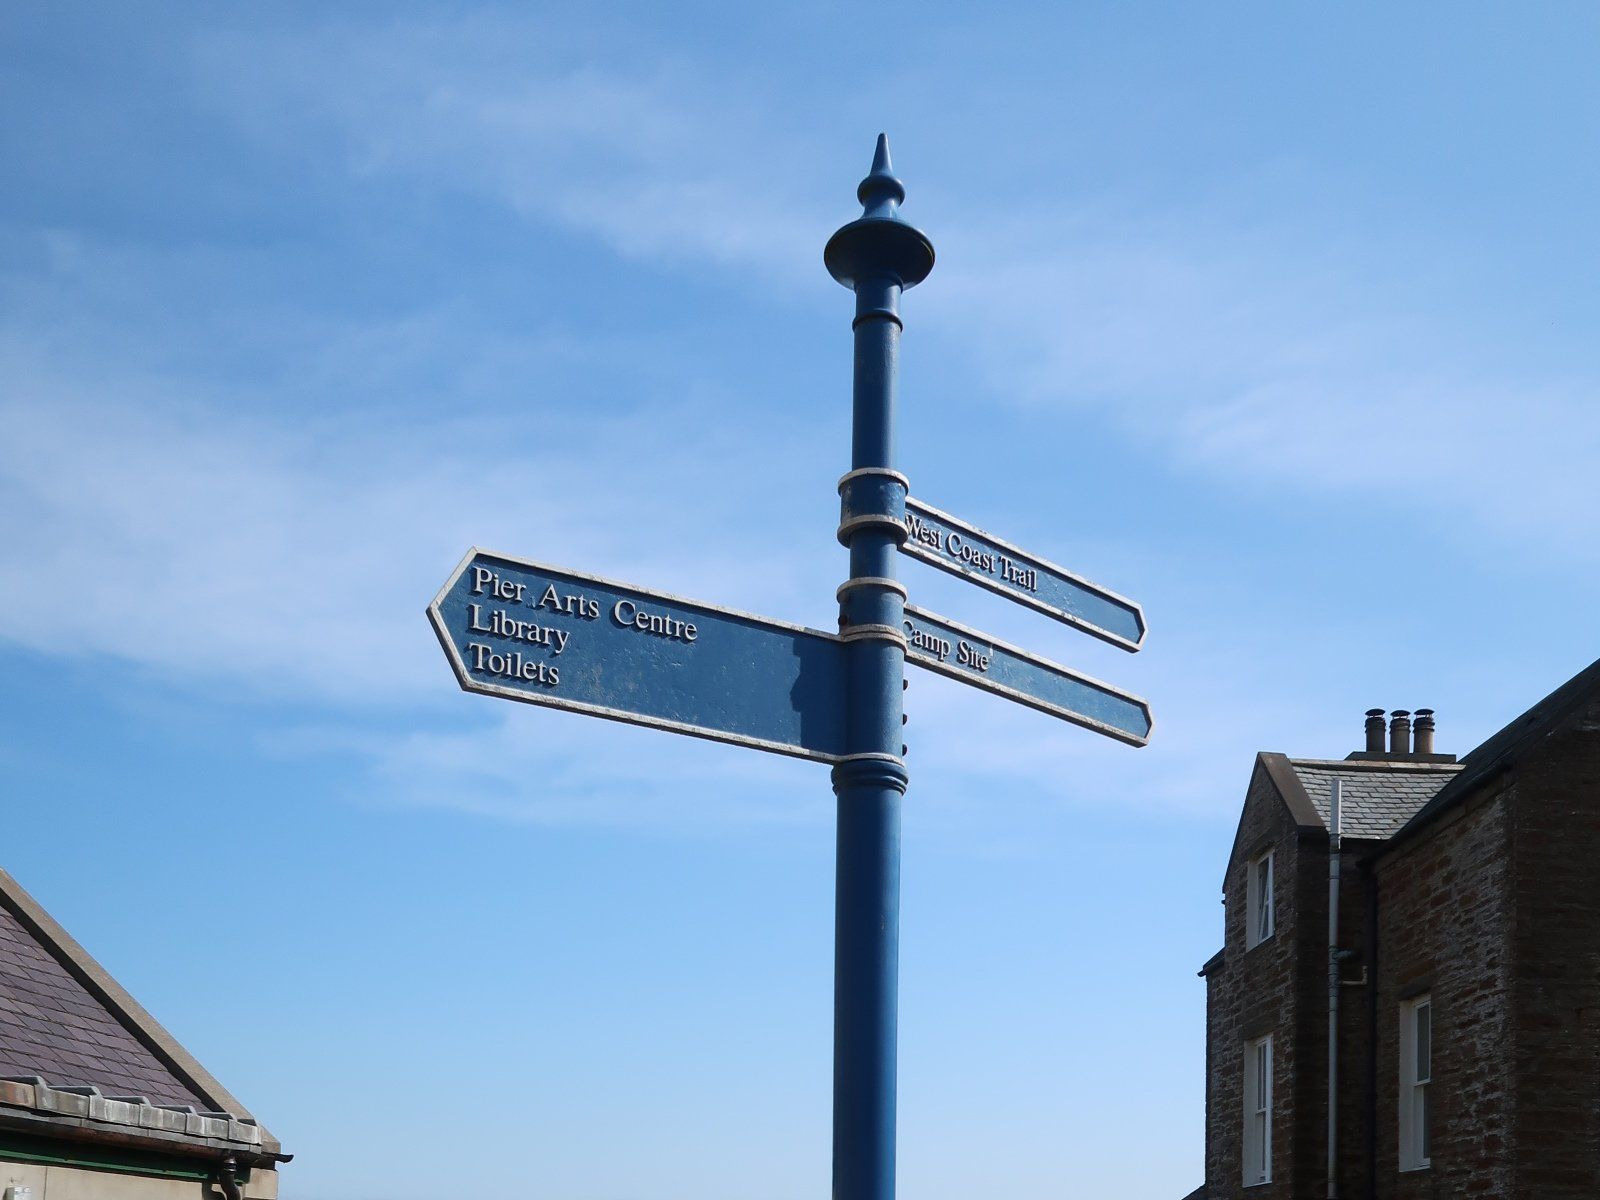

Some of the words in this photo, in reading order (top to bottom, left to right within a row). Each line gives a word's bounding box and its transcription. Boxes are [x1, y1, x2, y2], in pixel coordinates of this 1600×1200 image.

[905, 514, 943, 549] West
[947, 533, 996, 573] Coast
[998, 556, 1038, 591] Trail
[473, 567, 526, 602] Pier
[538, 584, 600, 617] Arts
[614, 600, 698, 640] Centre
[469, 605, 571, 654] Library
[469, 643, 560, 685] Toilets
[958, 640, 990, 671] Site
